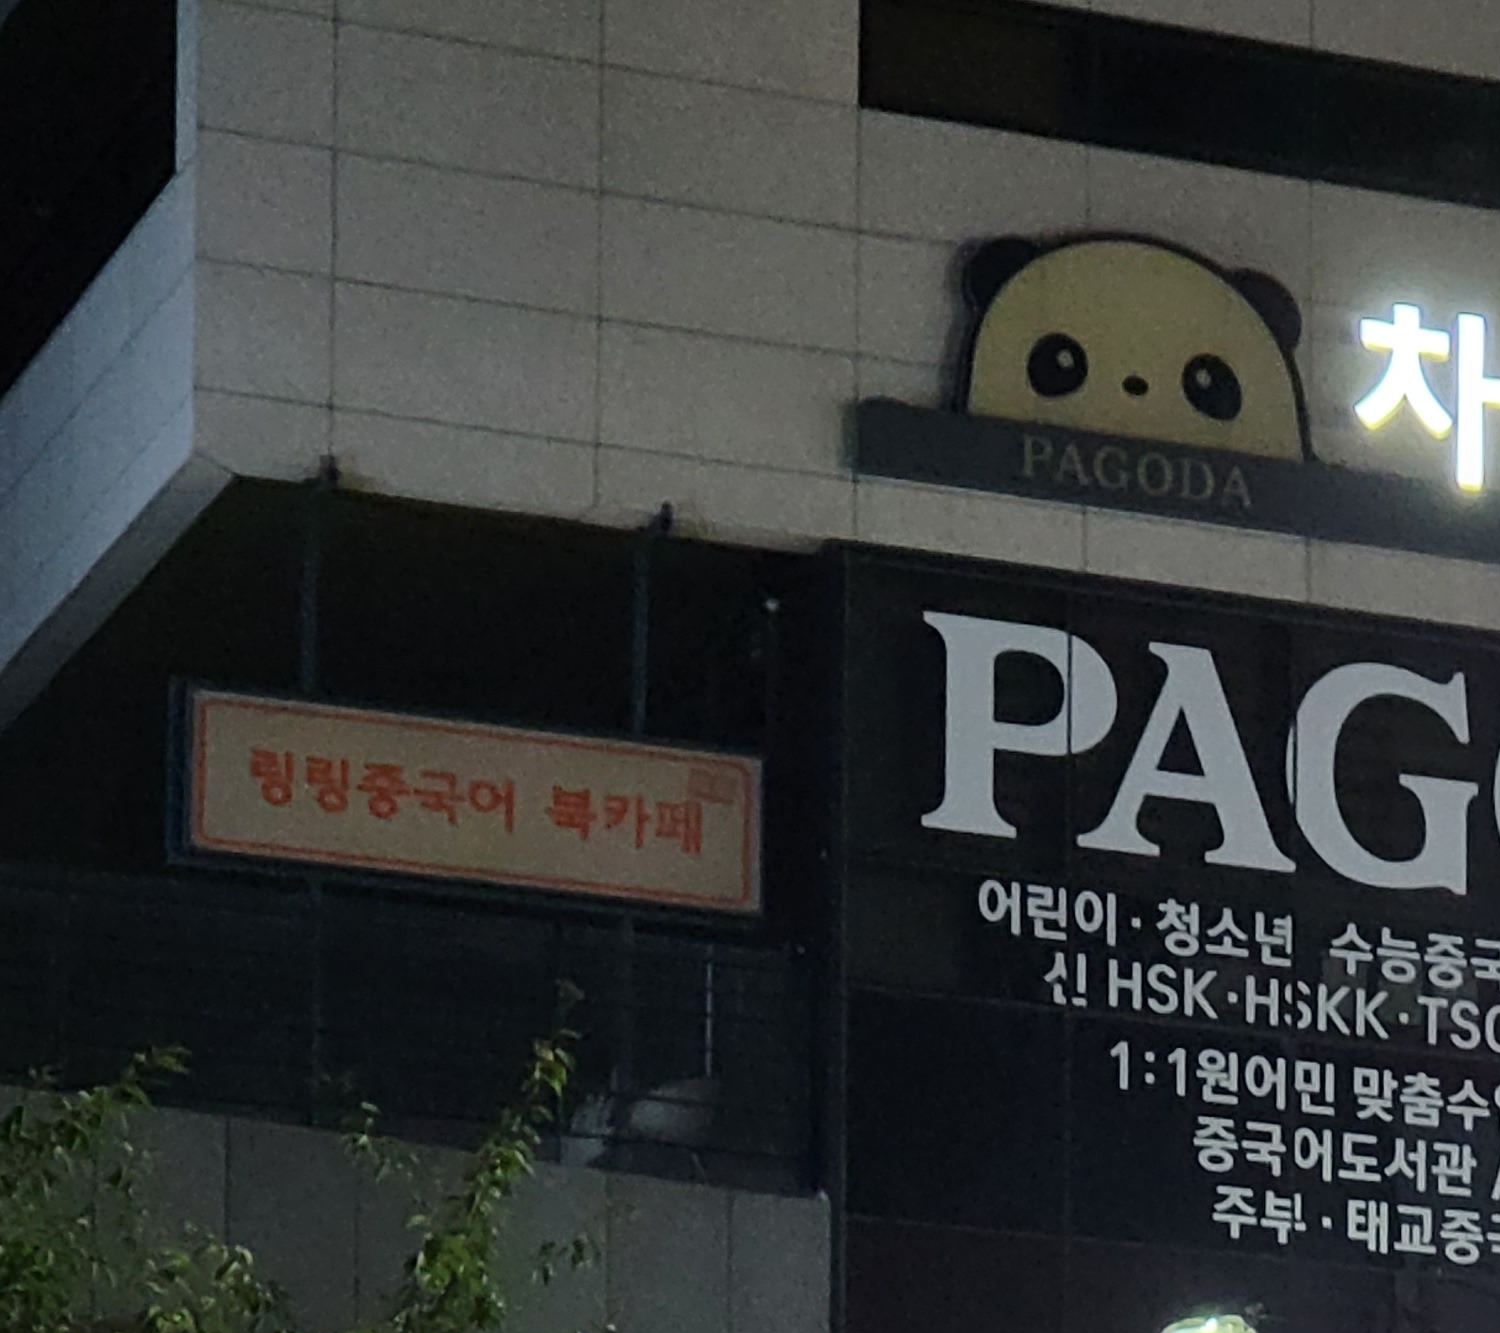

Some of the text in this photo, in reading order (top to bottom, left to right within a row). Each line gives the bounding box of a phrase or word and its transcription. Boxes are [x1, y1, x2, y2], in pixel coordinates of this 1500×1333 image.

[1020, 432, 1254, 508] PAGODA
[546, 784, 702, 855] 북카페
[1044, 951, 1087, 1008] 신
[1193, 1116, 1477, 1197] 중국어도서관
